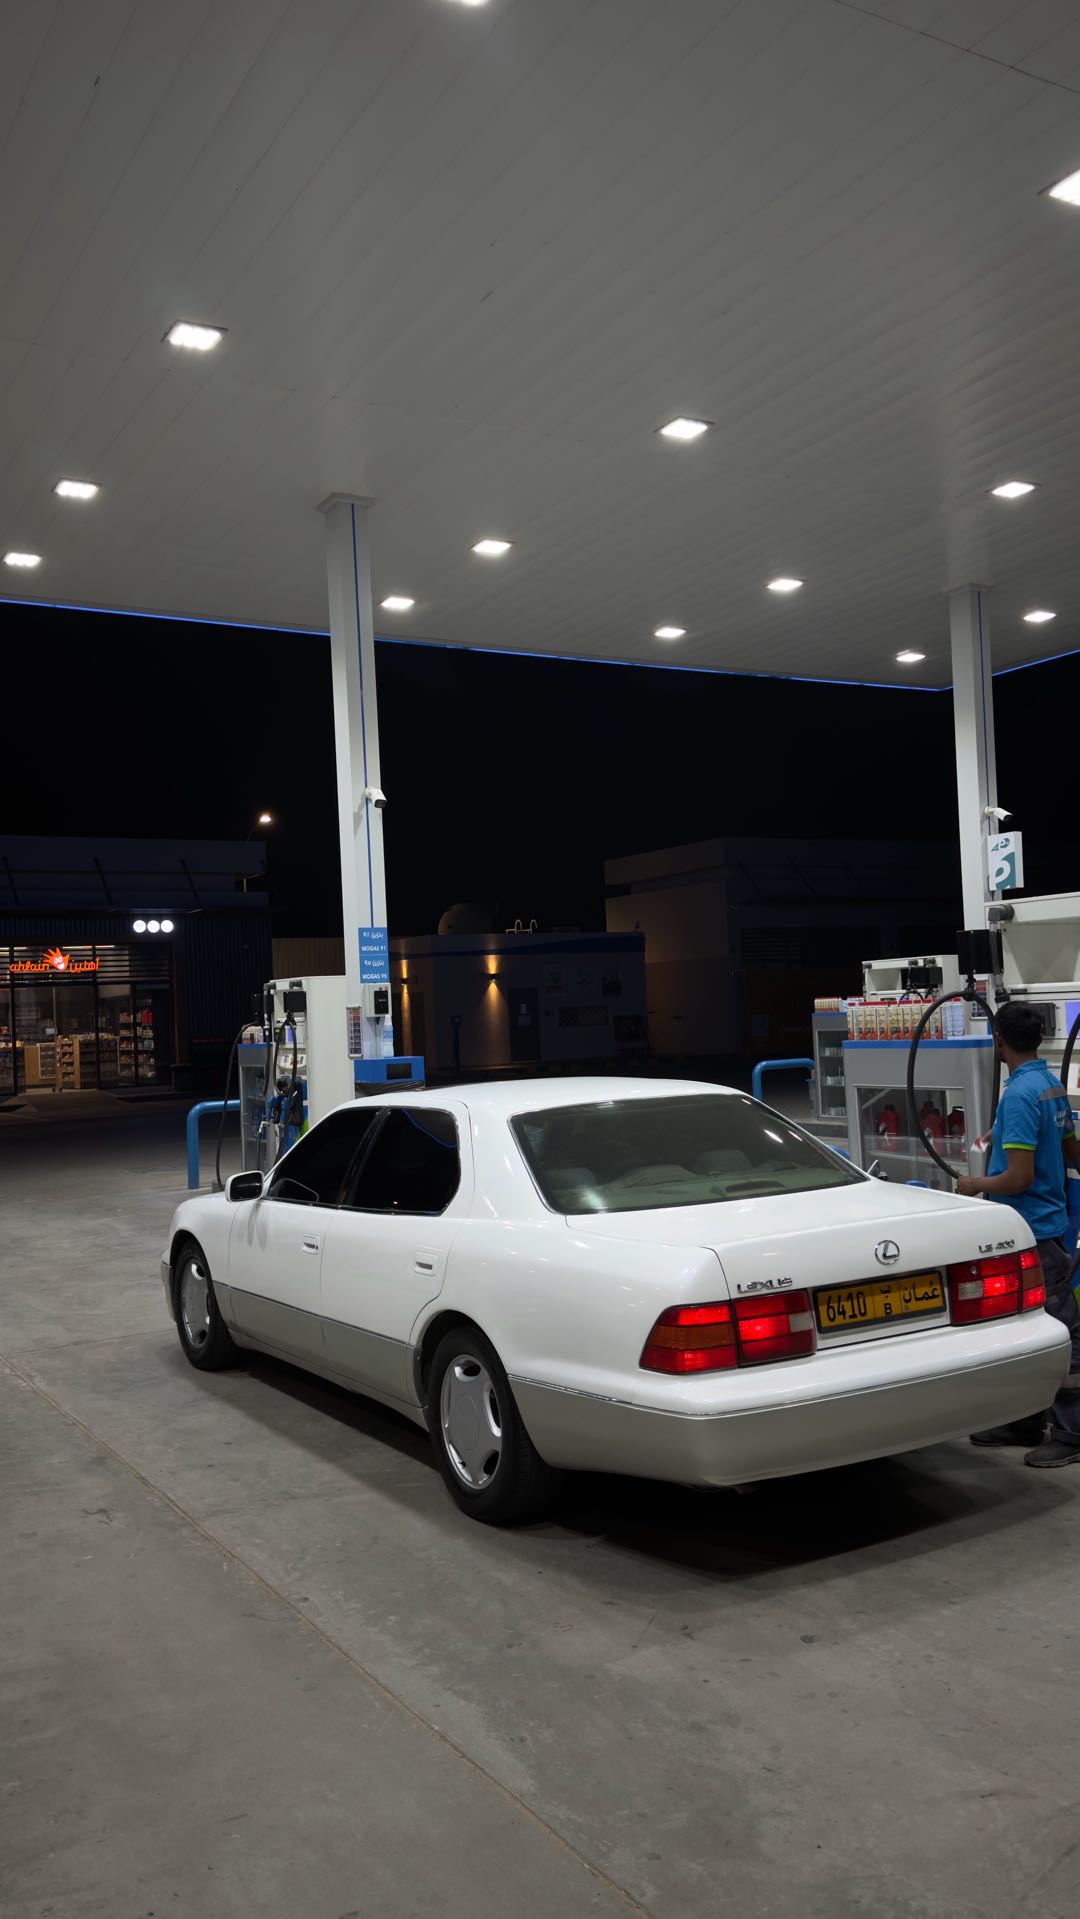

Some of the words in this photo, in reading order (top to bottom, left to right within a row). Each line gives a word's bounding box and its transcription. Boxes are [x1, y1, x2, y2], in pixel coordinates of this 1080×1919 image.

[9, 960, 50, 972] ahlain
[737, 1276, 793, 1294] LEXUS
[880, 1285, 891, 1298] ب
[826, 1291, 867, 1322] 6410
[883, 1302, 893, 1316] B
